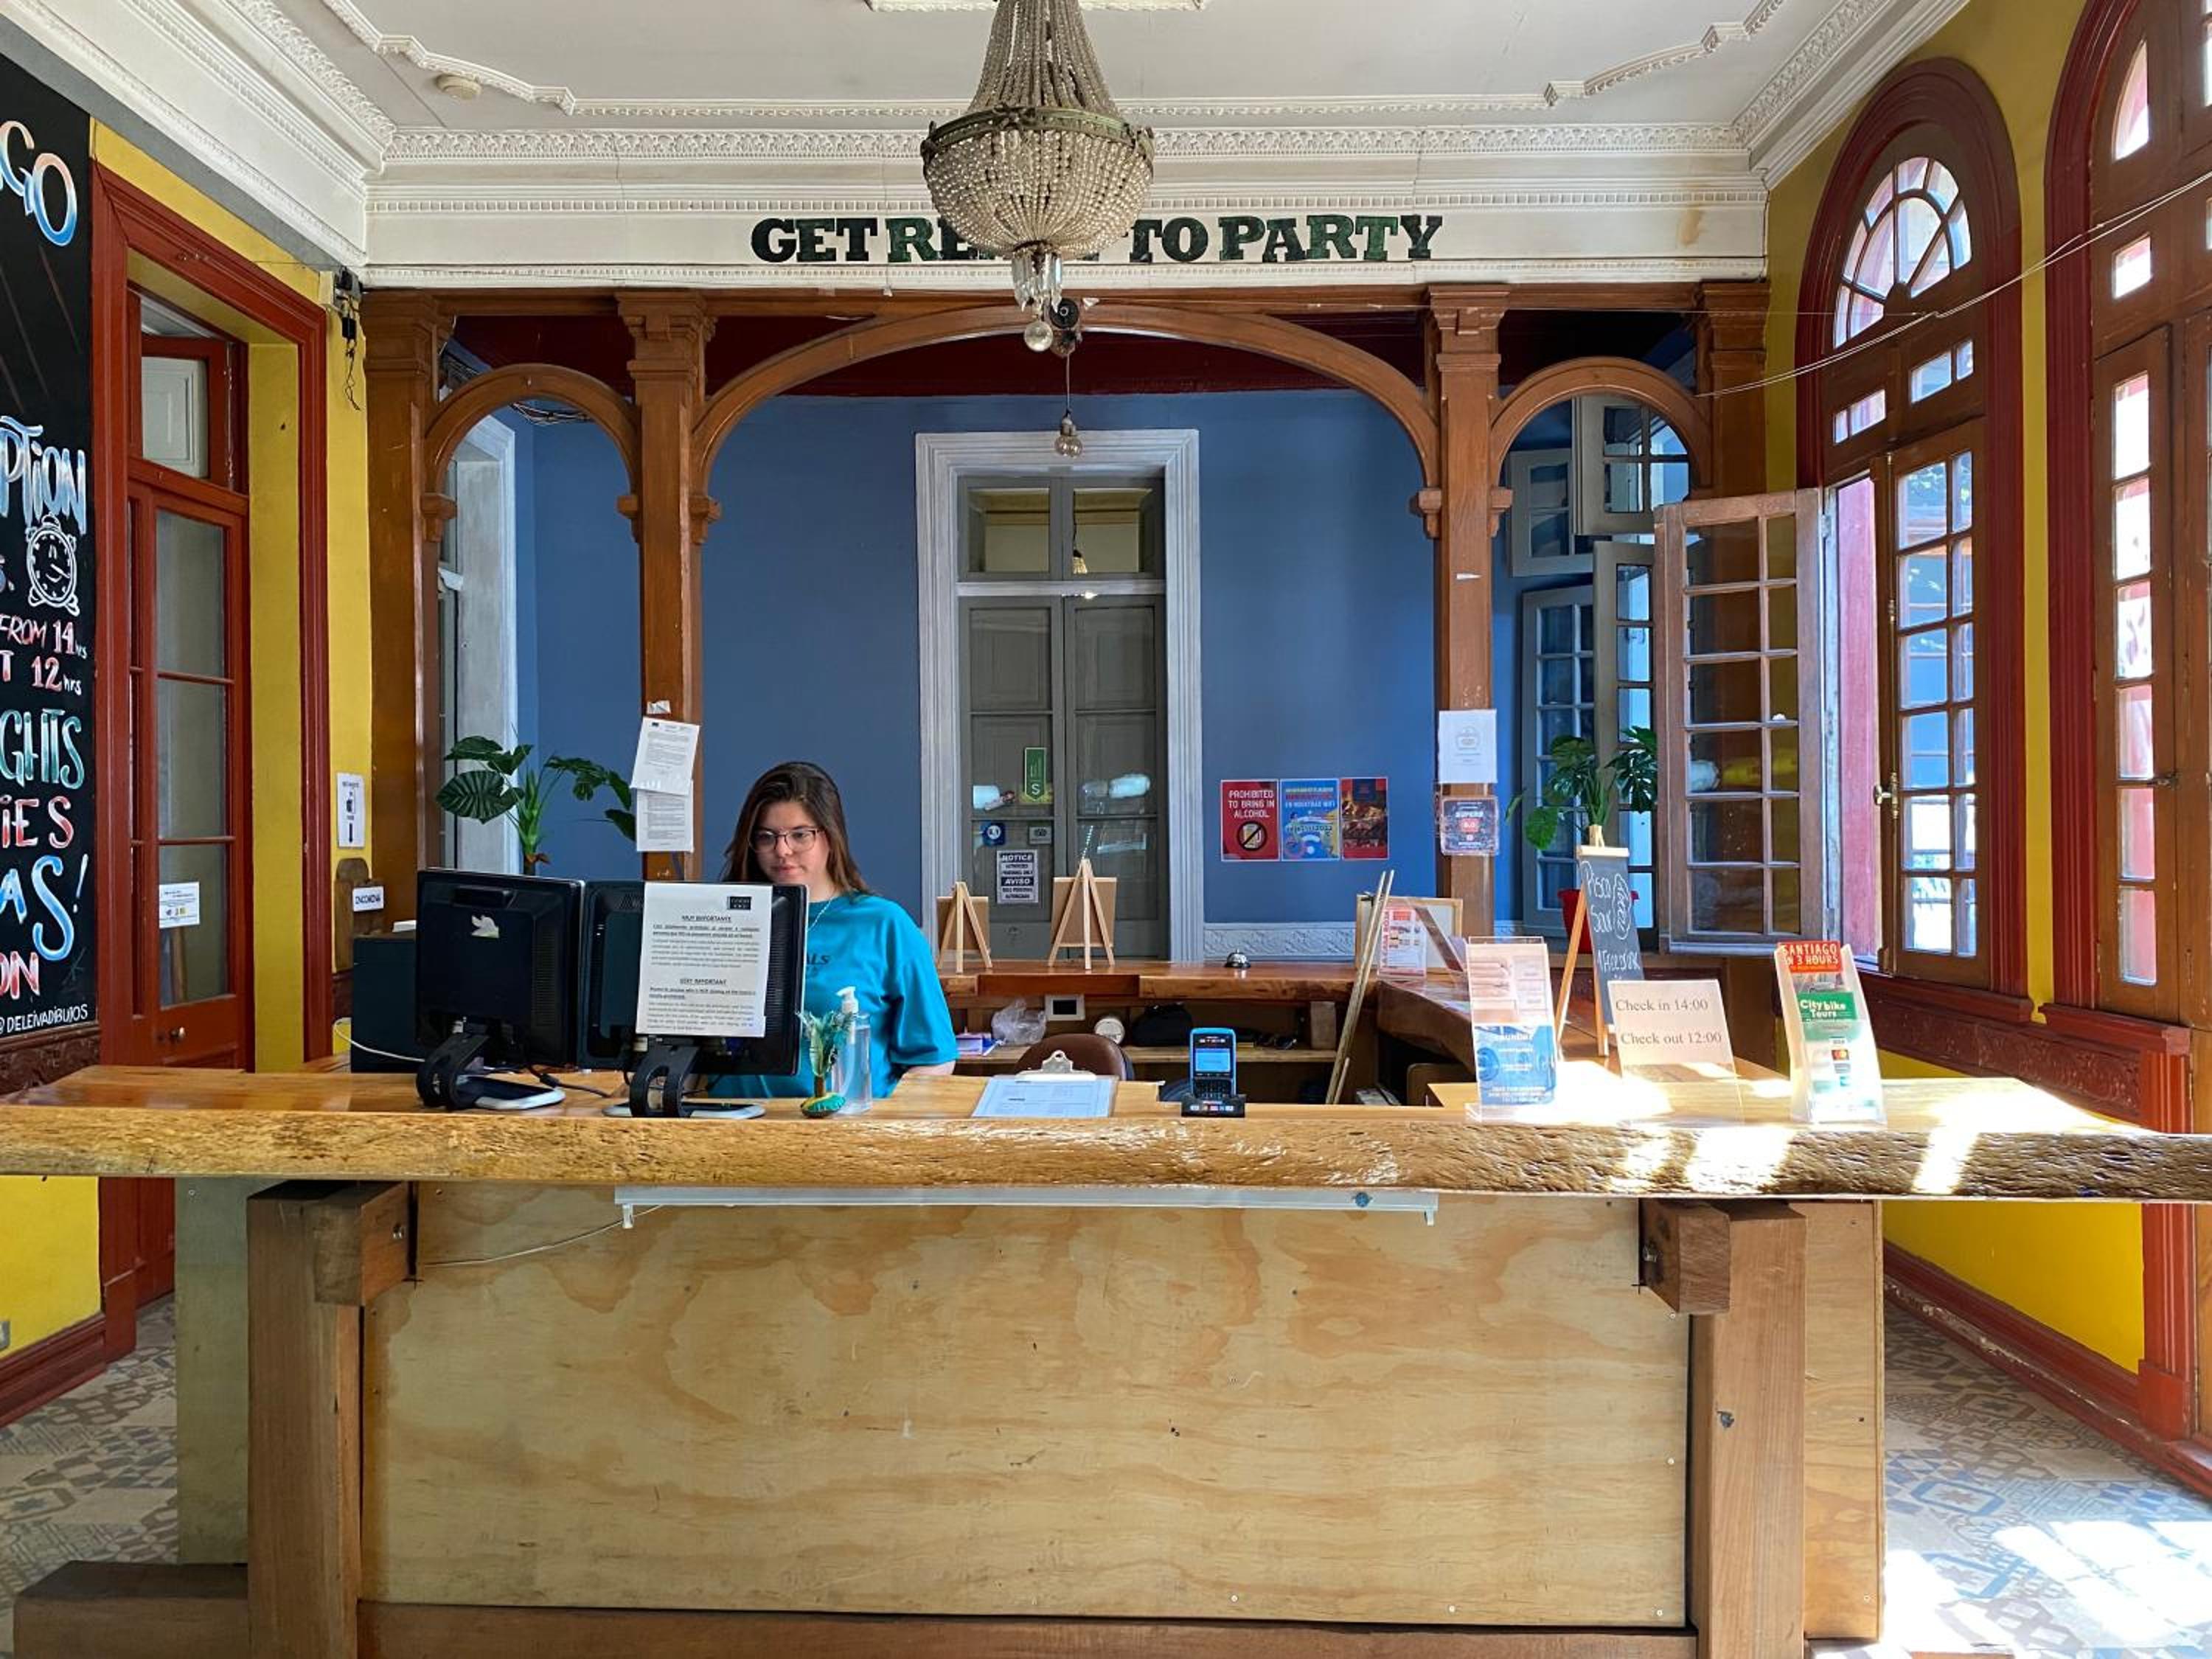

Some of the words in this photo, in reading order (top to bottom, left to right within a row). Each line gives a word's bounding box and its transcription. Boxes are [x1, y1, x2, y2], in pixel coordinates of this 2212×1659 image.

[751, 218, 877, 262] GET
[1129, 217, 1208, 262] TO
[1218, 215, 1443, 262] PARTY
[1228, 790, 1274, 799] PROHIBITED
[1228, 800, 1239, 809] TO
[1241, 800, 1265, 809] BRING
[1267, 799, 1275, 808] IN
[1234, 809, 1270, 819] ALCOHOL
[1781, 943, 1837, 956] SANTIAGO
[1797, 956, 1803, 965] 3
[1806, 956, 1838, 965] HOURS
[1615, 998, 1655, 1011] Check
[1659, 998, 1670, 1010] in
[1674, 998, 1708, 1010] 14:00
[1800, 999, 1822, 1011] City
[1823, 1001, 1846, 1011] bike
[1810, 1009, 1837, 1018] Tours
[1621, 1032, 1659, 1045] Check
[1663, 1034, 1684, 1044] out
[1688, 1032, 1722, 1043] 12:00
